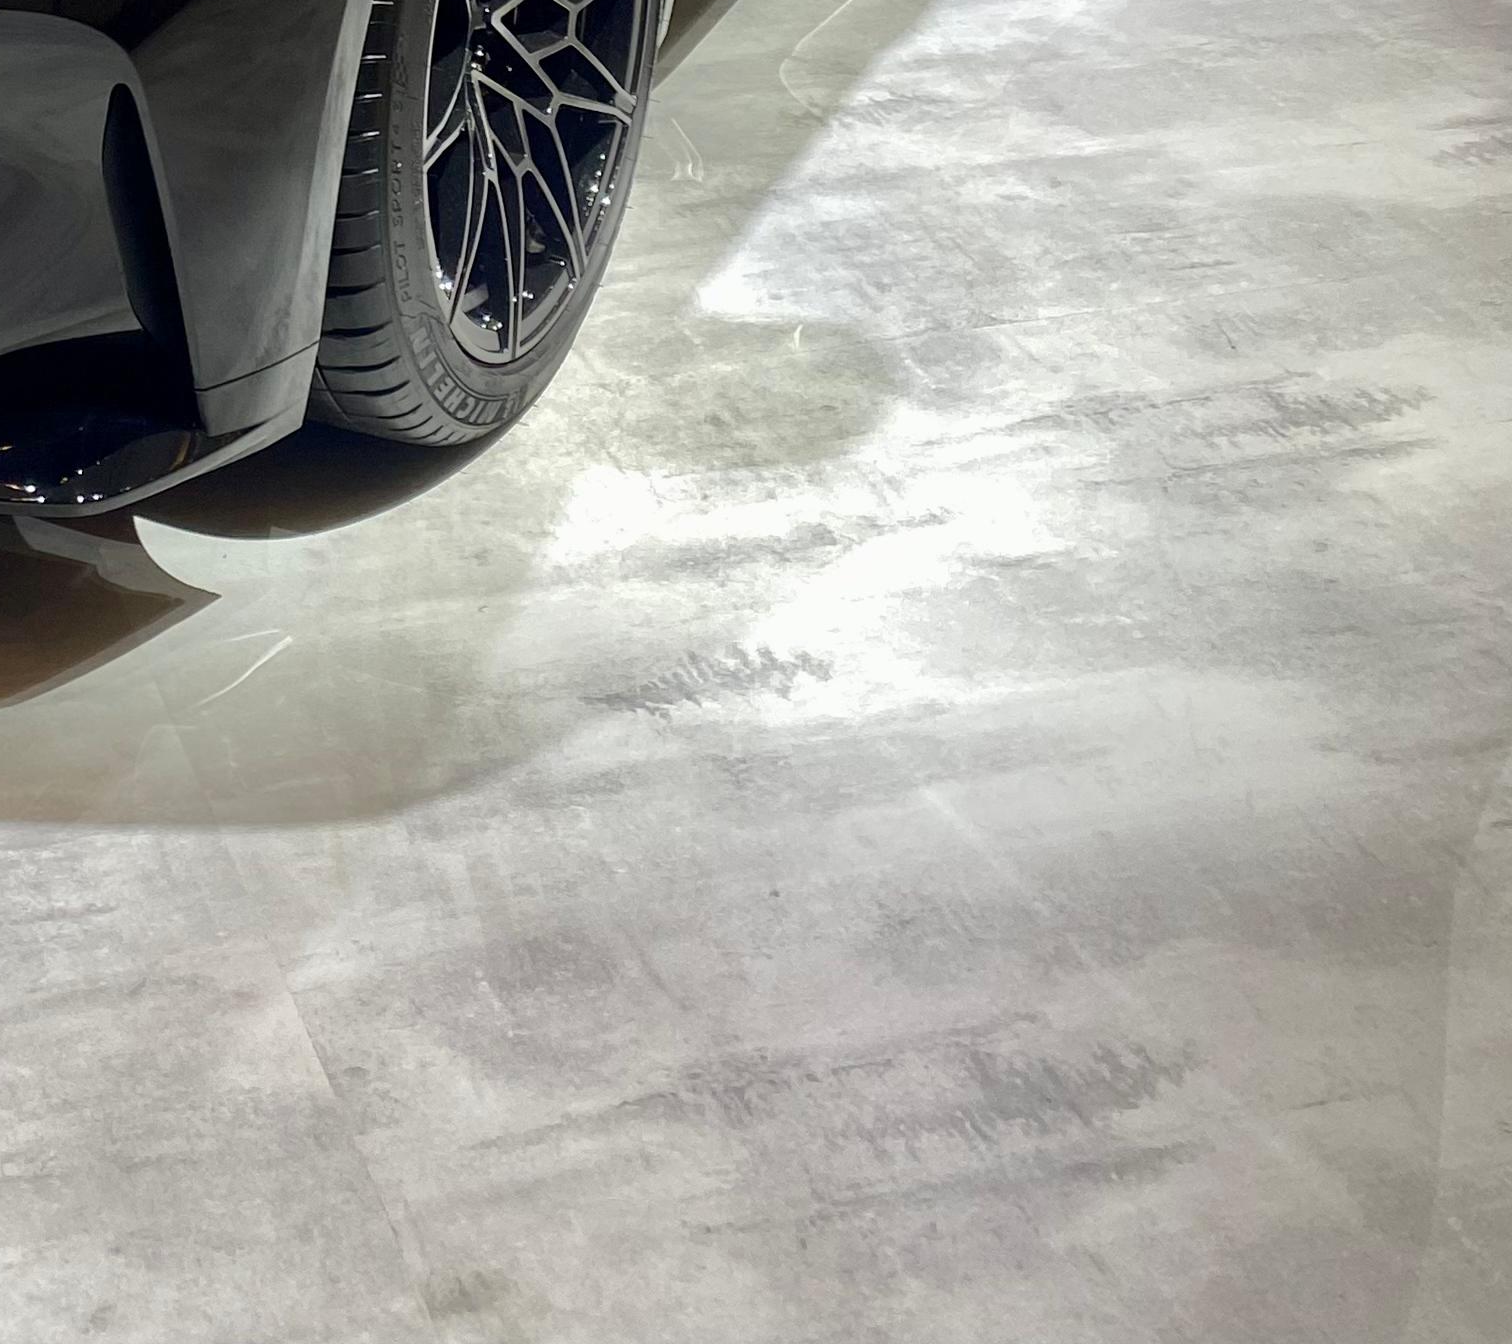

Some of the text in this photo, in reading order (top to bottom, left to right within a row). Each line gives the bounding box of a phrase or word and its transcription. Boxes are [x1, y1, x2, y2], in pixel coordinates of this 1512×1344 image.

[391, 141, 405, 227] SPORT
[392, 241, 413, 304] PILOT
[409, 326, 506, 425] MICHELIN
